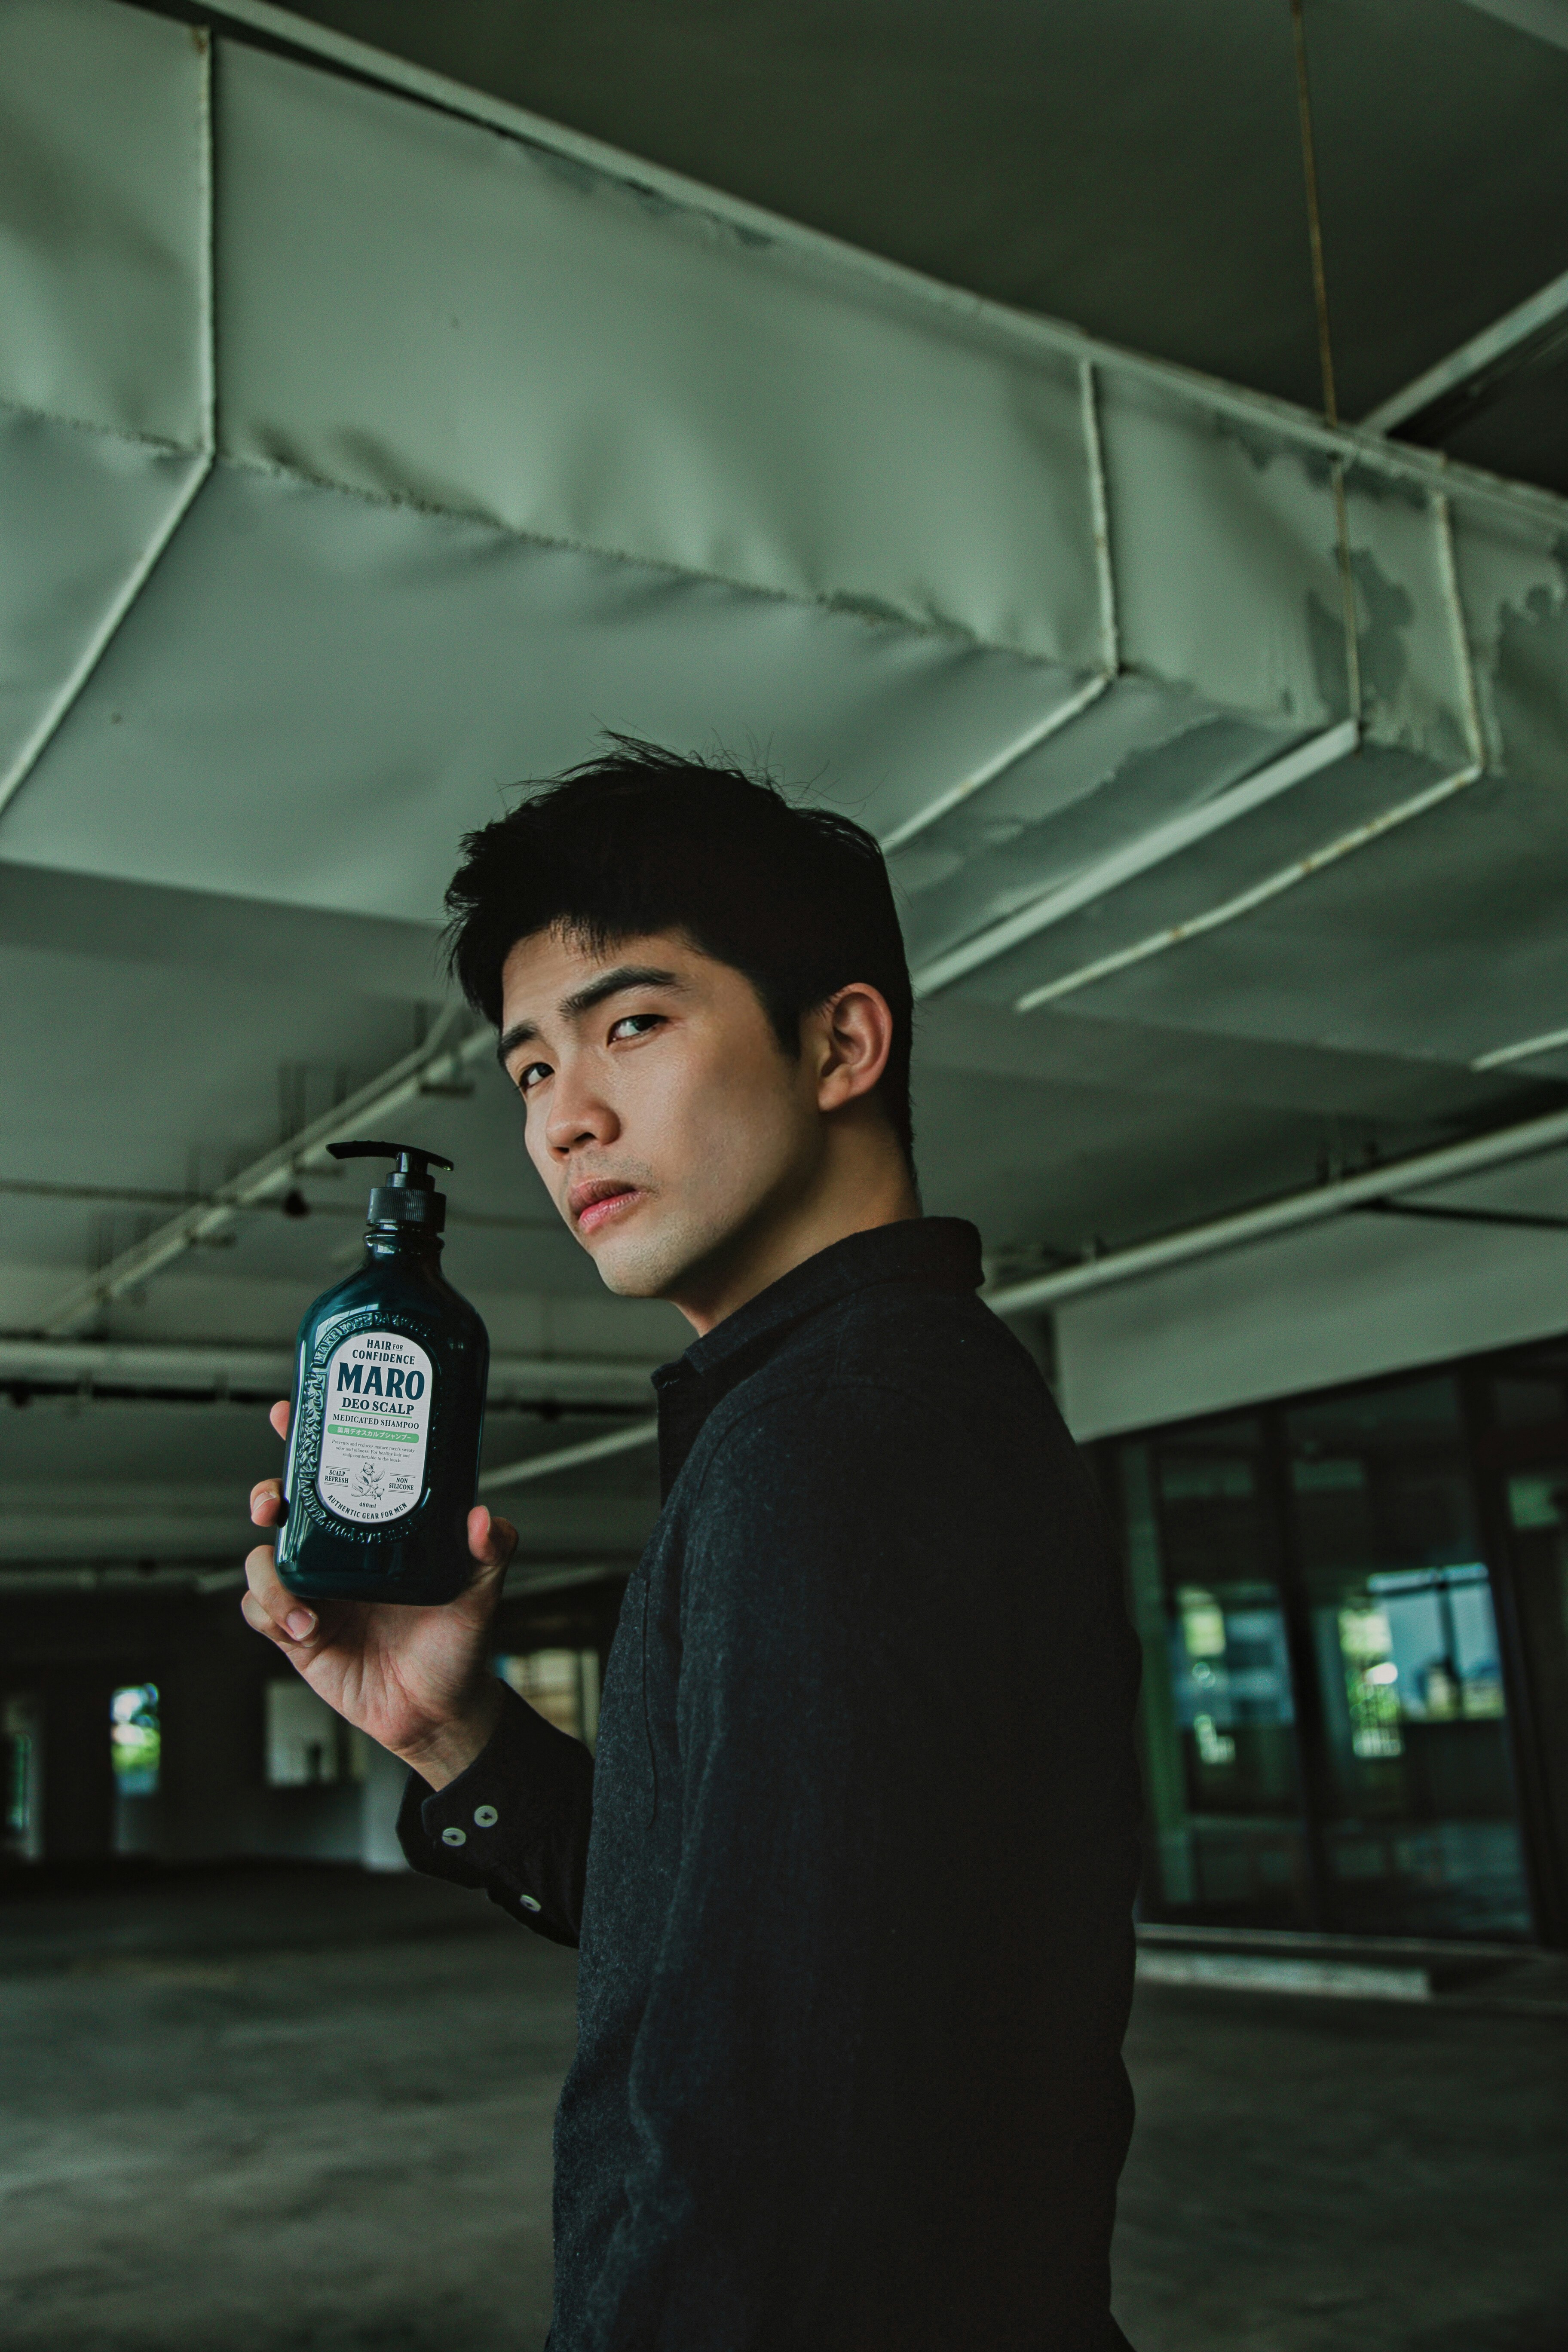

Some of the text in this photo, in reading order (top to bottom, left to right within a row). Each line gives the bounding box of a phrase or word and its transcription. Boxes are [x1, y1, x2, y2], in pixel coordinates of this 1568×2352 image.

[367, 1339, 391, 1351] HAIR
[352, 1350, 415, 1365] CONFIDENCE
[337, 1362, 425, 1400] MARO
[342, 1397, 414, 1415] DEO SCALP
[333, 1414, 419, 1430] MEDICATED SHAMPOO
[337, 1427, 411, 1440] 薬用デオスカルプシャンプー
[327, 1494, 360, 1518] AUTHENTIC
[394, 1502, 408, 1513] MEN
